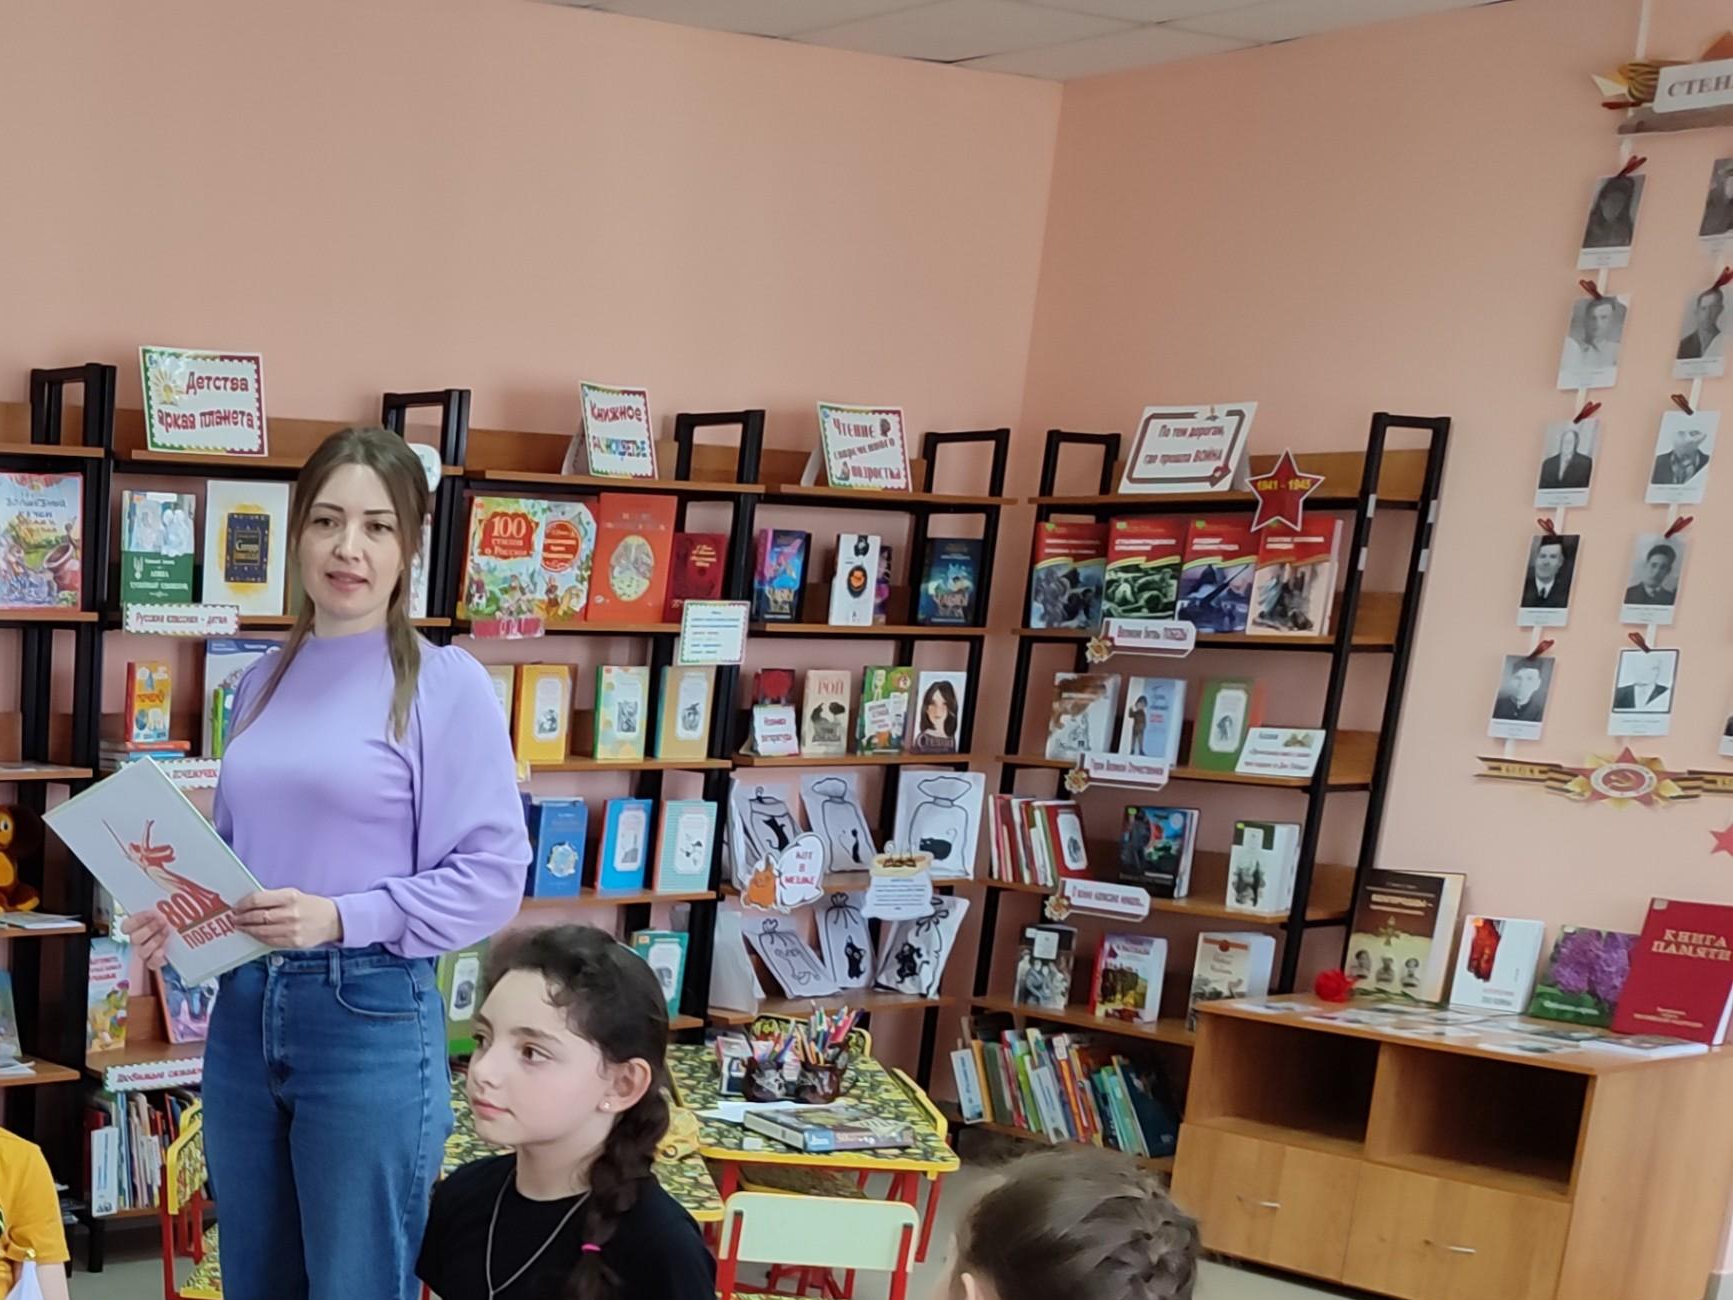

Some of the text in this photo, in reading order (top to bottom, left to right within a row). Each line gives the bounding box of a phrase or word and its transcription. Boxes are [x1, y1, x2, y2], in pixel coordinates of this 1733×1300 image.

[1667, 74, 1733, 98] СТЕН
[186, 371, 249, 395] Детства
[157, 409, 254, 432] яркая планета
[590, 400, 642, 422] Книжное
[833, 418, 876, 438] Чтение
[1158, 425, 1170, 438] По
[1257, 480, 1278, 491] 1941
[1288, 479, 1312, 491] 1945
[491, 516, 526, 538] 100
[1664, 928, 1728, 949] КНИГА
[1651, 941, 1732, 963] ПАМЯТИ
